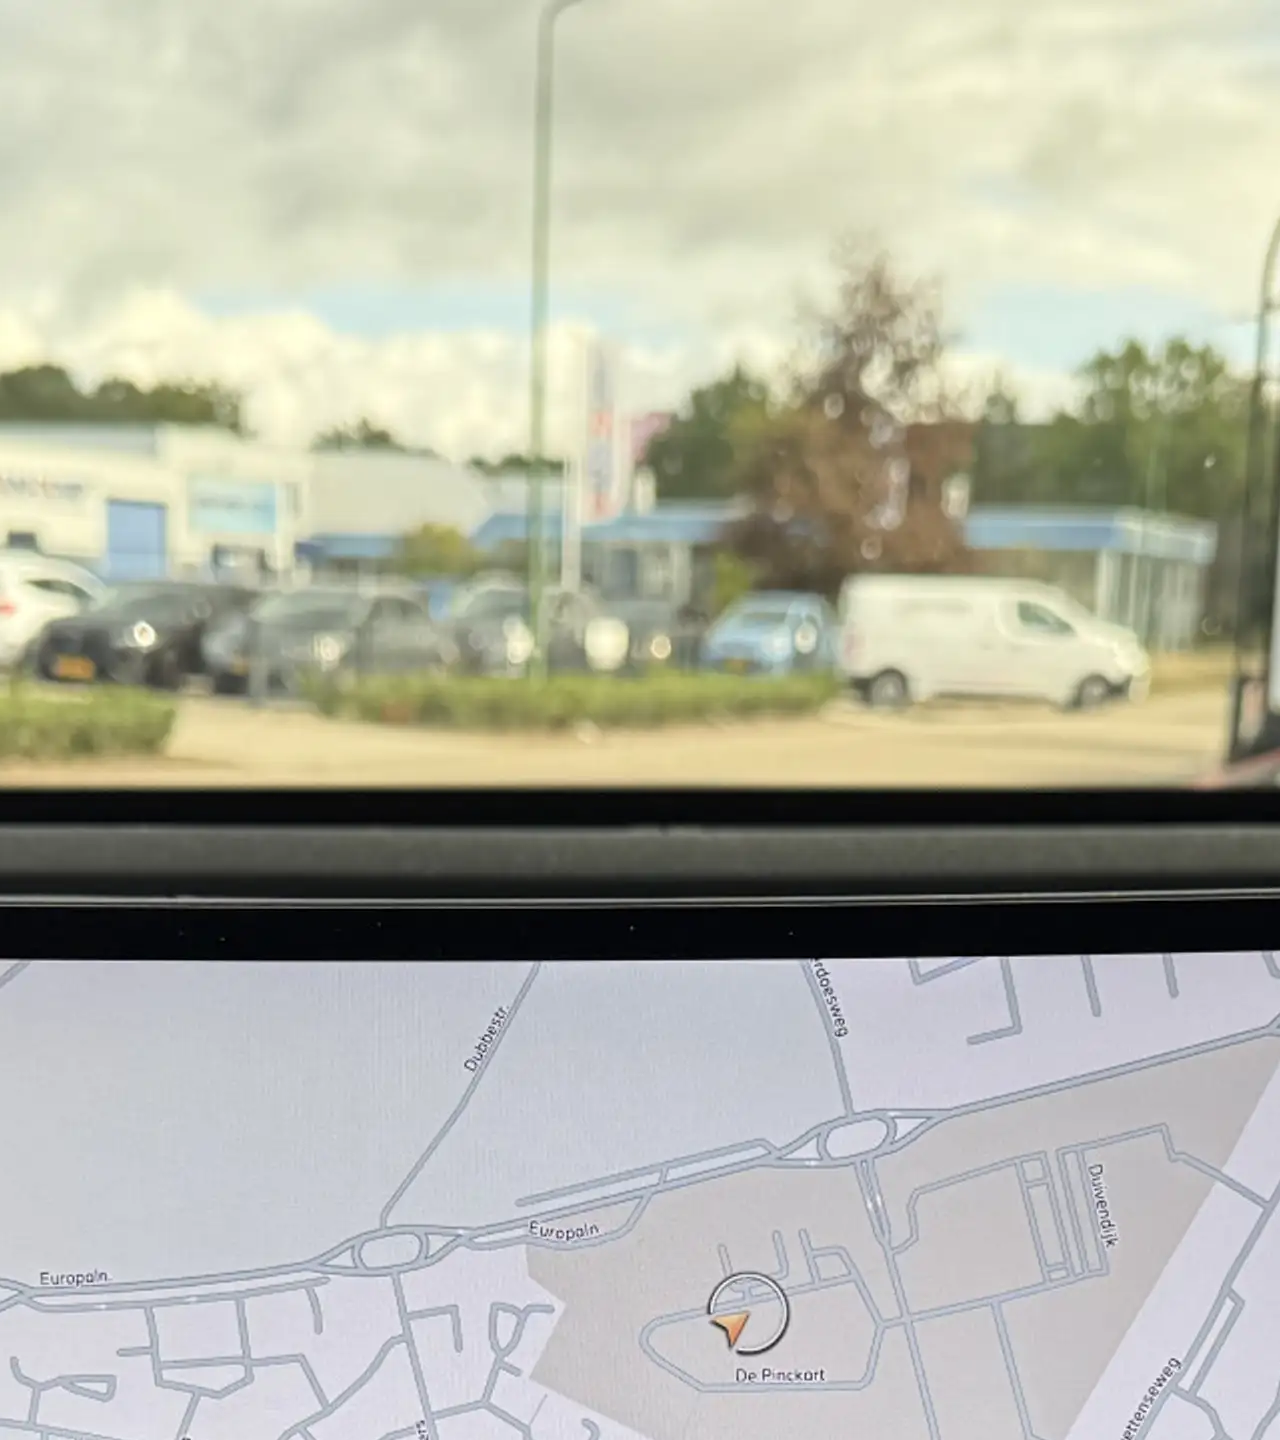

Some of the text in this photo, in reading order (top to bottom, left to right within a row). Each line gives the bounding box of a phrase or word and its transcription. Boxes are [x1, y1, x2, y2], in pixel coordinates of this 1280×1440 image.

[463, 1004, 510, 1072] Dubbestr.
[1087, 1163, 1119, 1249] Duivendijk
[735, 1367, 825, 1382] De Pinckart
